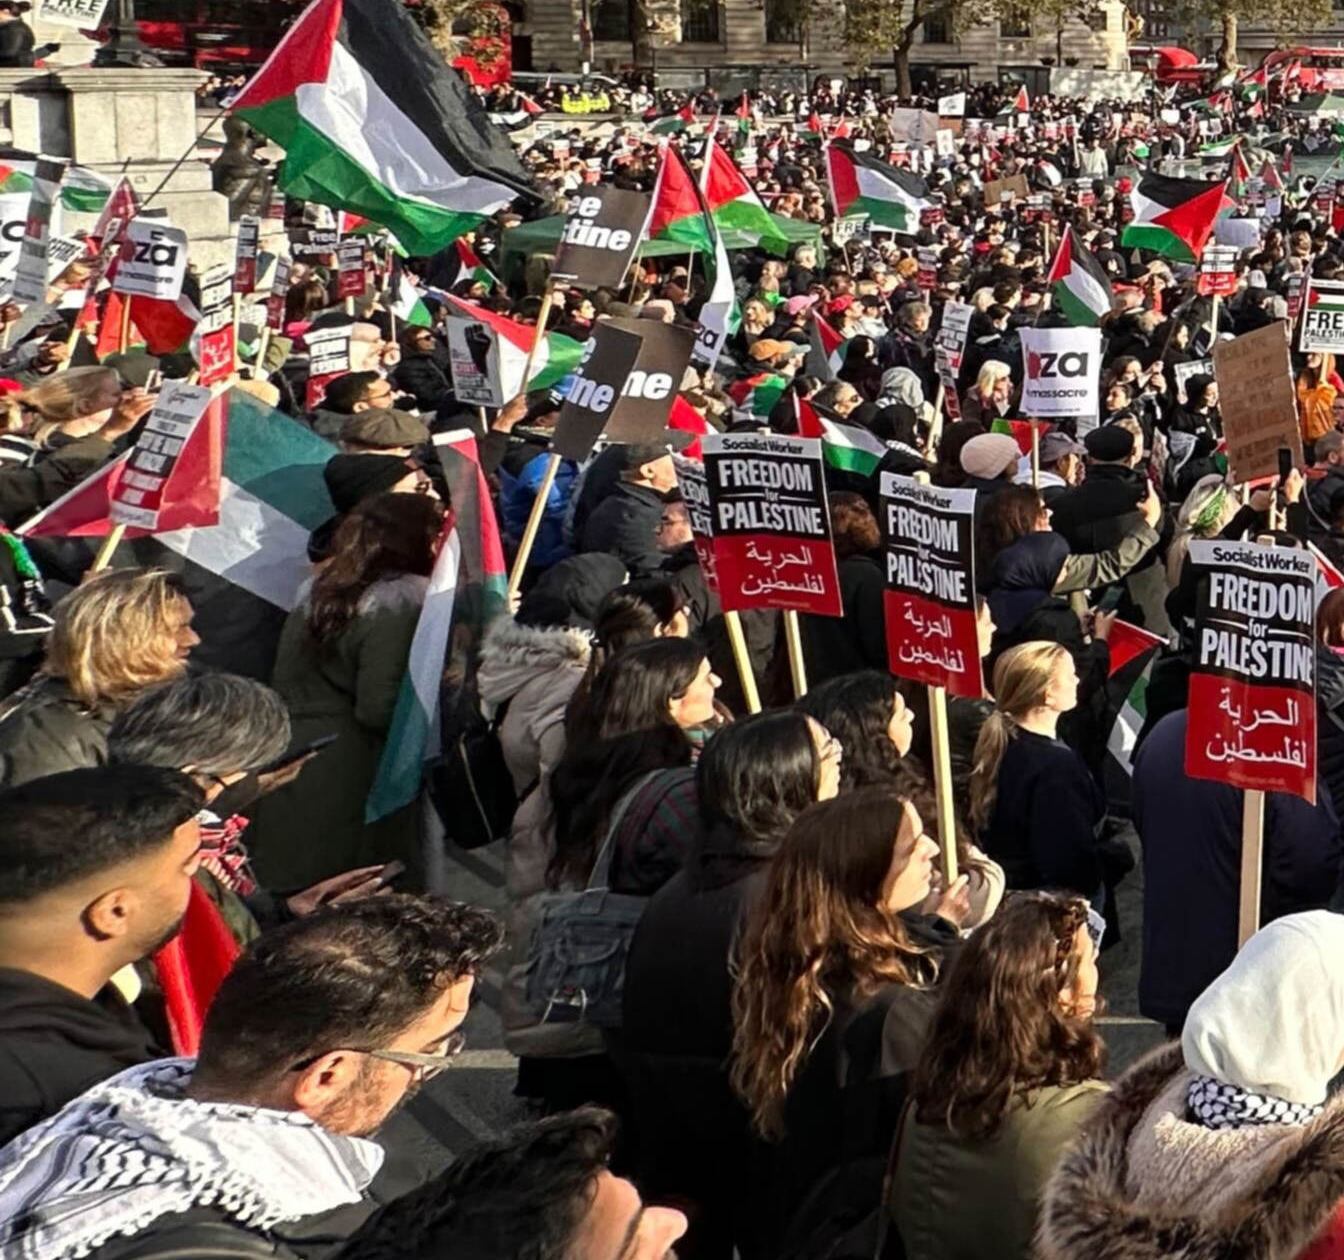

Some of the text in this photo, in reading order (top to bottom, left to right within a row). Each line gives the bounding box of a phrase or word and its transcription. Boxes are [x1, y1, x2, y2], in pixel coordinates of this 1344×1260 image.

[1027, 351, 1088, 383] za
[722, 439, 803, 454] Socialist Worker
[717, 459, 813, 491] FREEDOM
[718, 502, 825, 535] PALESTINE
[887, 504, 959, 552] FREEDOM
[746, 541, 812, 569] الحرية
[1213, 547, 1310, 573] Socialist Worker
[741, 568, 825, 595] لفلسطين
[887, 552, 967, 602] PALESTINE
[1209, 572, 1312, 625] FREEDOM
[1248, 618, 1268, 638] for
[1200, 628, 1313, 686] PALESTINE
[1218, 686, 1298, 731] الحرية
[1206, 730, 1306, 768] لفلسطين
